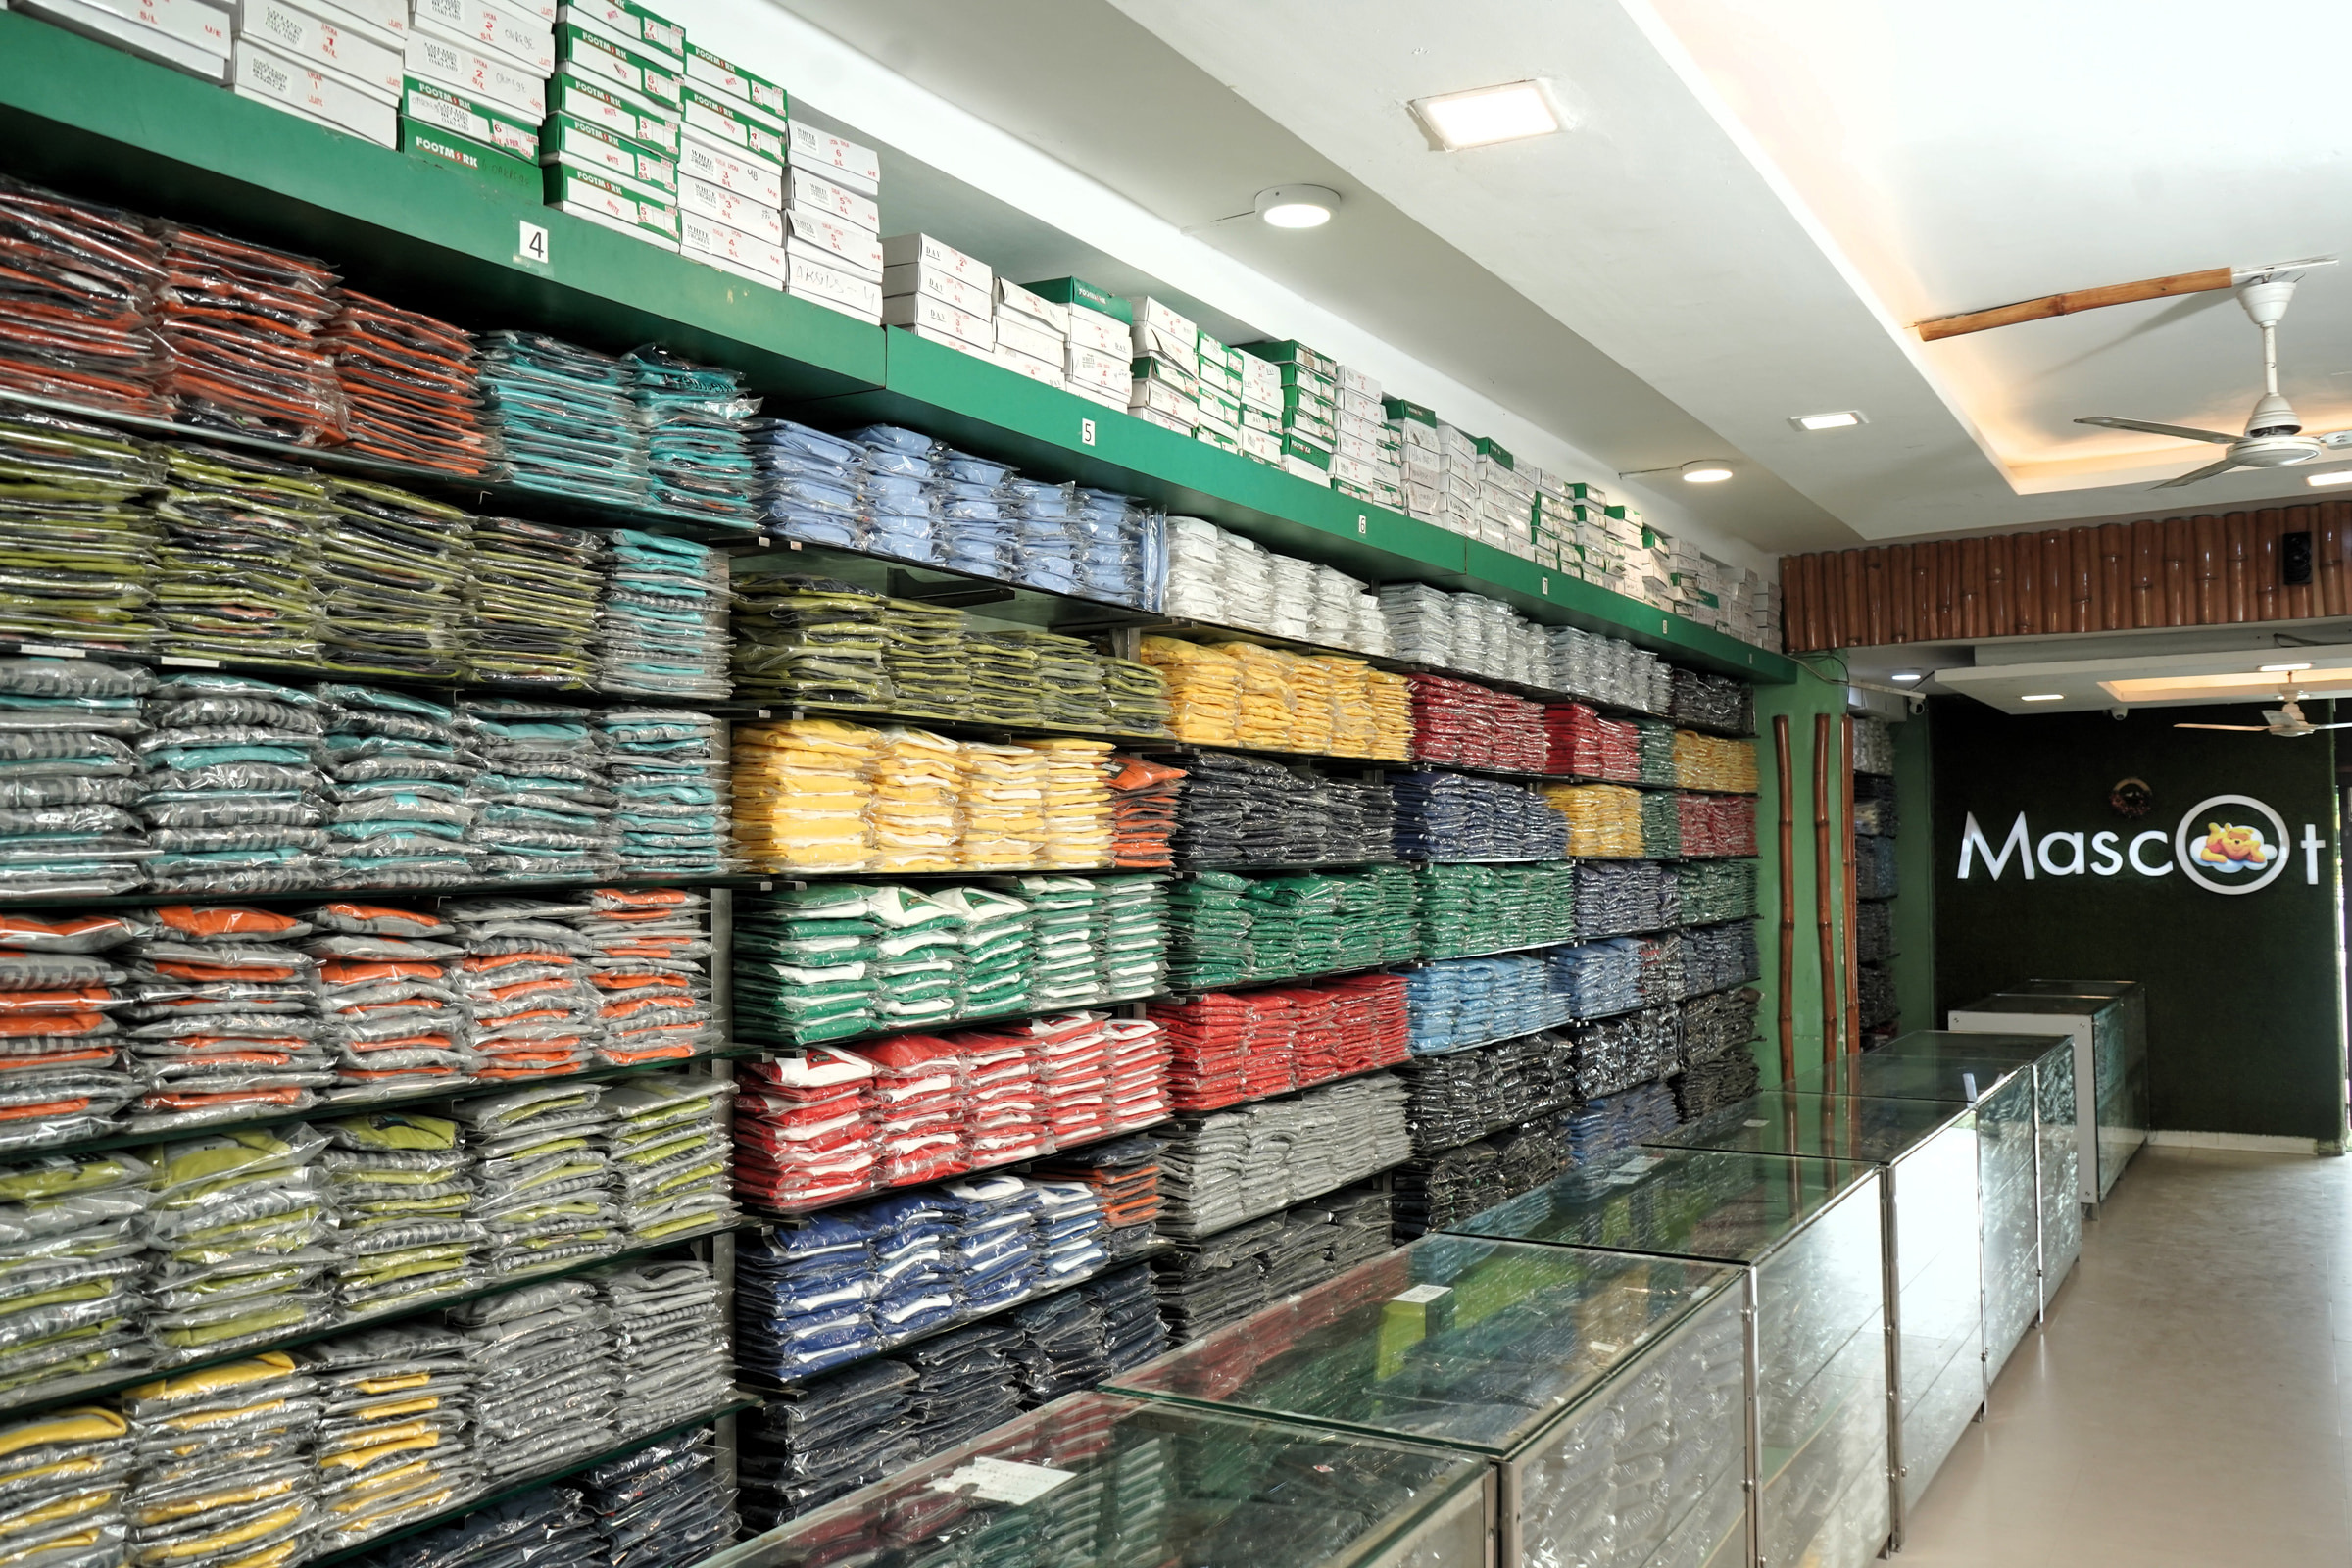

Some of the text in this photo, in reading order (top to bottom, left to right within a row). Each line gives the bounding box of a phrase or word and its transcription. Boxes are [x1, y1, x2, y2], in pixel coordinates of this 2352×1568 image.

[485, 21, 494, 31] 2
[646, 23, 654, 31] 7
[475, 69, 483, 79] 2
[647, 74, 655, 84] 6
[494, 123, 502, 133] 6
[640, 120, 648, 129] 3
[640, 162, 647, 171] 5
[722, 171, 729, 179] 3
[725, 200, 732, 209] 3
[640, 206, 647, 216] 5
[529, 231, 544, 258] 4
[1084, 422, 1092, 442] 5
[1360, 517, 1365, 533] 6
[1957, 794, 2326, 895] Mascot
